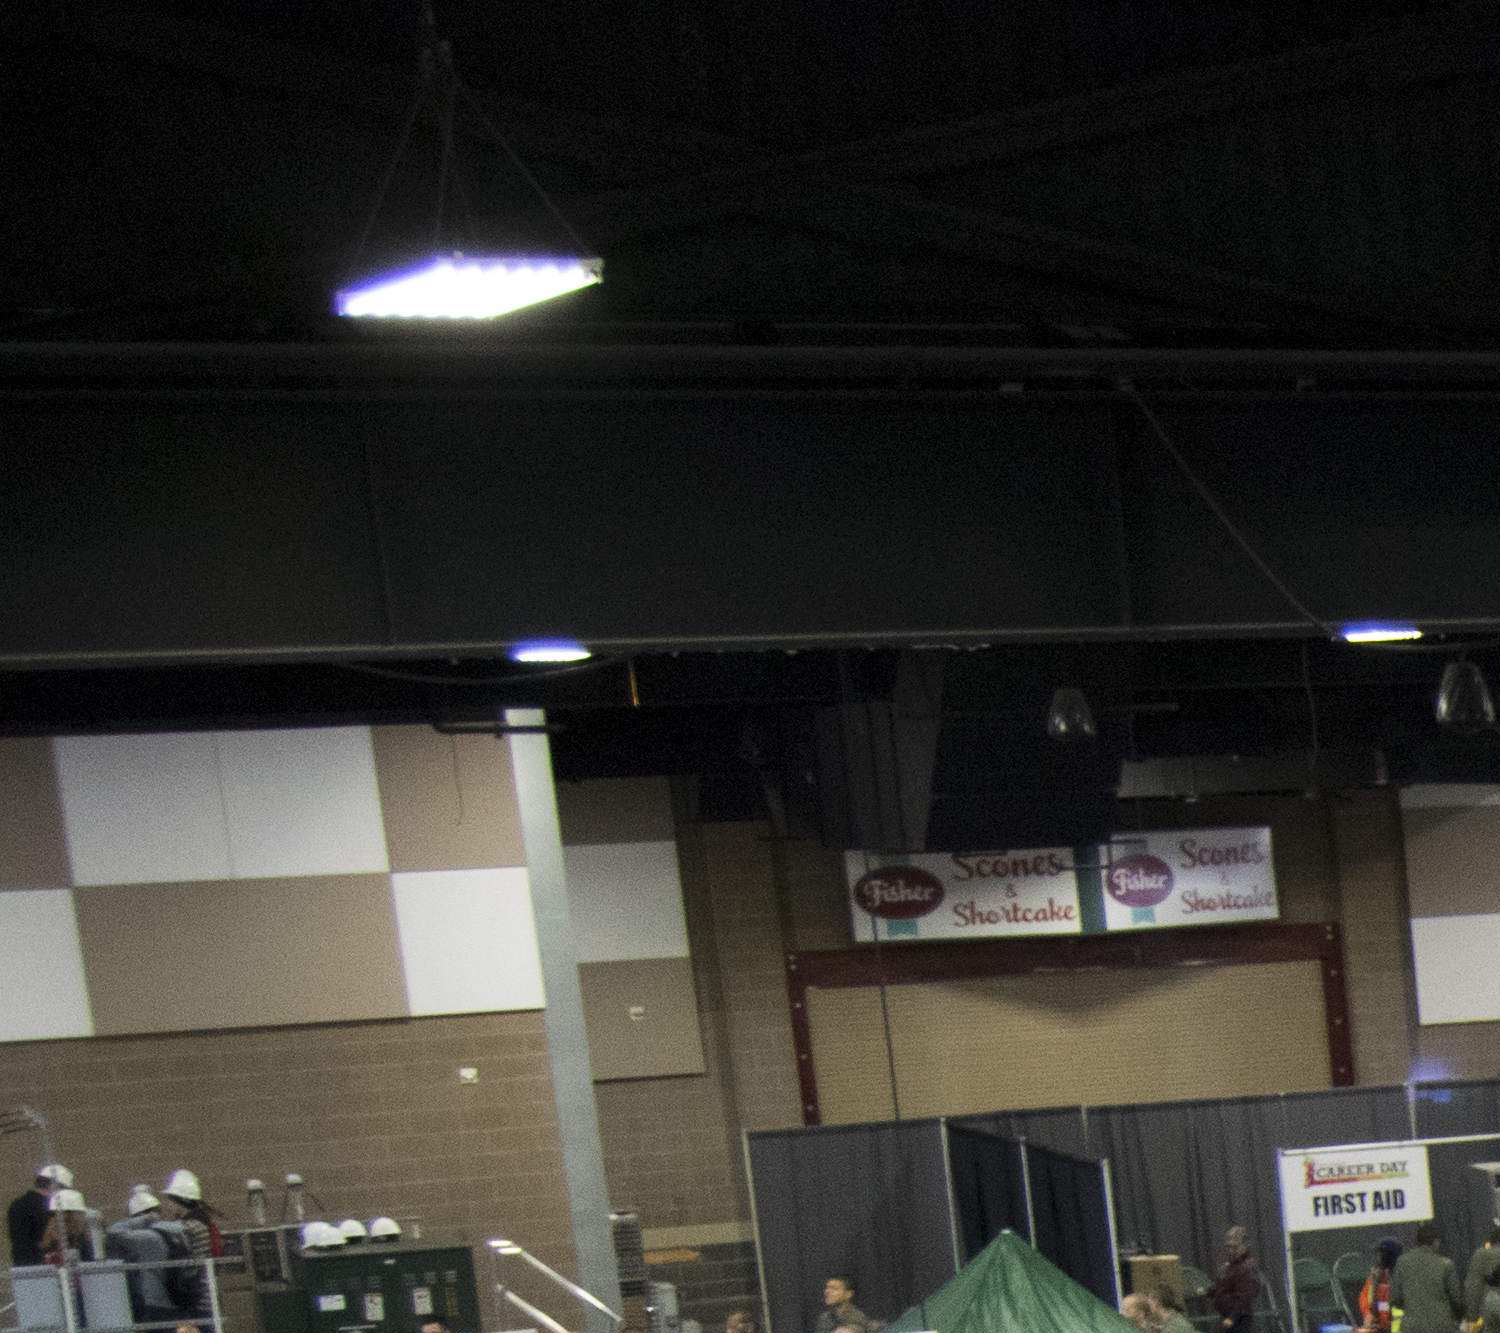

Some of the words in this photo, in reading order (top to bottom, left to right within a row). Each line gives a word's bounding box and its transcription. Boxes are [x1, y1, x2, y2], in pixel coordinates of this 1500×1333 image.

[952, 853, 1063, 881] Scones
[1180, 838, 1265, 869] Scones
[862, 877, 935, 903] Fisher
[1112, 867, 1169, 896] Fisher
[953, 902, 1076, 928] Shortcake
[1181, 887, 1274, 915] Shortcake
[1315, 1160, 1372, 1178] CAREER
[1376, 1157, 1409, 1174] DAY
[1312, 1189, 1366, 1214] FIRST
[1373, 1185, 1405, 1210] AID
